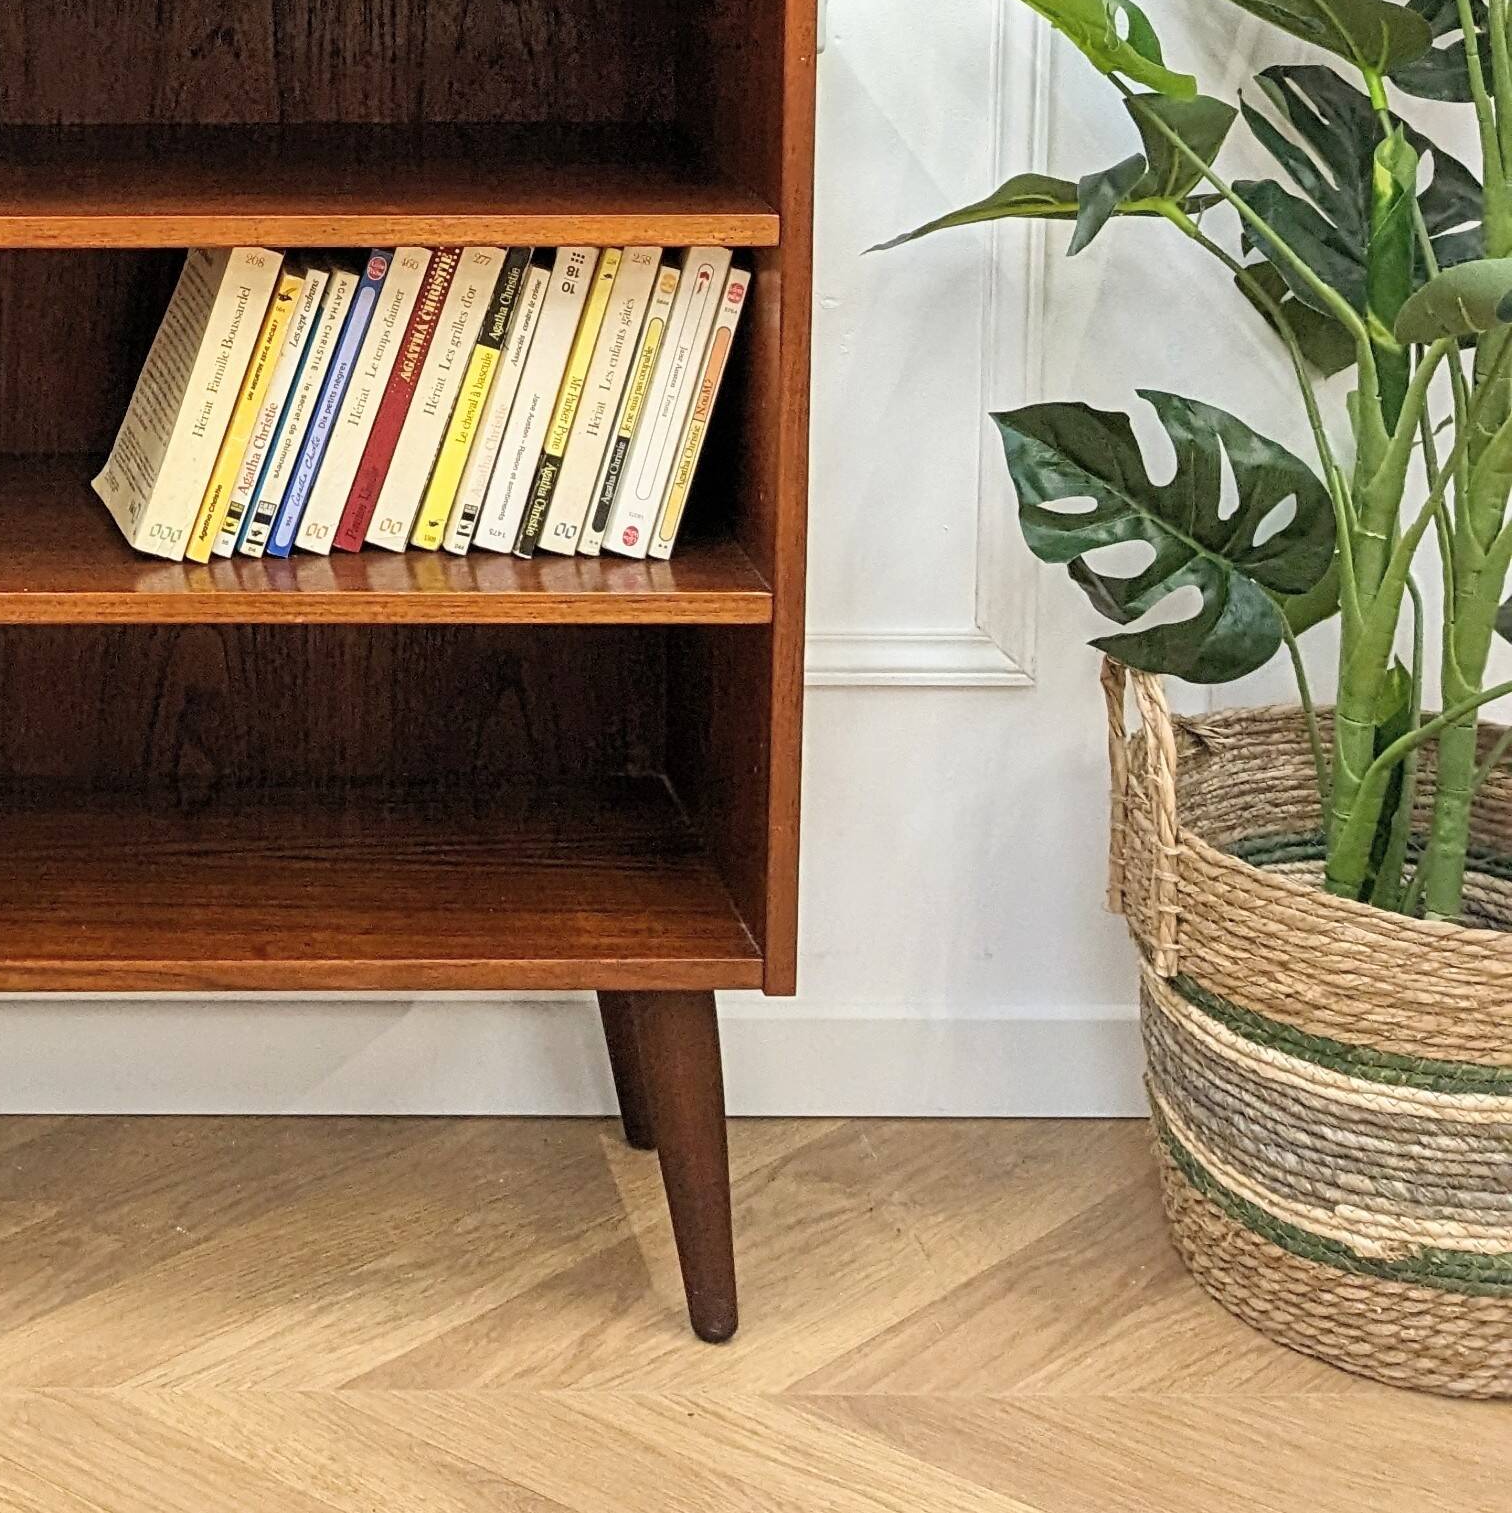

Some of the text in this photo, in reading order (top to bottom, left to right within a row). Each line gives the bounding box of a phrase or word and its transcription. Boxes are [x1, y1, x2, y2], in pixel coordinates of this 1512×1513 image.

[245, 254, 265, 268] 208
[561, 280, 576, 295] 10
[566, 264, 580, 279] 18
[289, 278, 319, 347] Les sept cadrans
[329, 281, 347, 319] AGATHA
[400, 253, 452, 381] AGATHA CHRISTIE
[489, 266, 520, 340] Agatha Christie
[527, 300, 535, 309] le
[530, 279, 542, 300] crime
[312, 324, 332, 370] CHRISTIE
[520, 309, 532, 331] contre
[193, 287, 252, 438] Hériat Famille Boussardel
[348, 387, 370, 426] Hériat
[364, 360, 378, 378] Le
[372, 328, 392, 362] temps
[424, 283, 477, 415] Hériat Les grilles d'or
[586, 297, 636, 436] Hériat Les enfants gâtés
[670, 363, 681, 388] Austen
[294, 393, 308, 420] secret
[304, 382, 312, 391] le
[318, 361, 348, 429] Dix petits nègres
[456, 352, 493, 443] Le cheval à bascule
[529, 392, 540, 412] Jane
[551, 376, 581, 450] Mr Parker Pyne
[622, 345, 654, 432] Je ne suis pas coupable
[238, 402, 278, 495] Agatha Christie
[289, 422, 297, 435] de
[471, 403, 507, 497] Agatha Christie
[521, 413, 534, 438] Austen
[510, 471, 517, 480] et
[601, 440, 625, 503] Agatha Christie
[676, 425, 700, 489] Agatha Christie
[198, 484, 223, 540] Agatha Christie
[498, 481, 515, 520] sentiments
[526, 462, 556, 537] Agatha Christie
